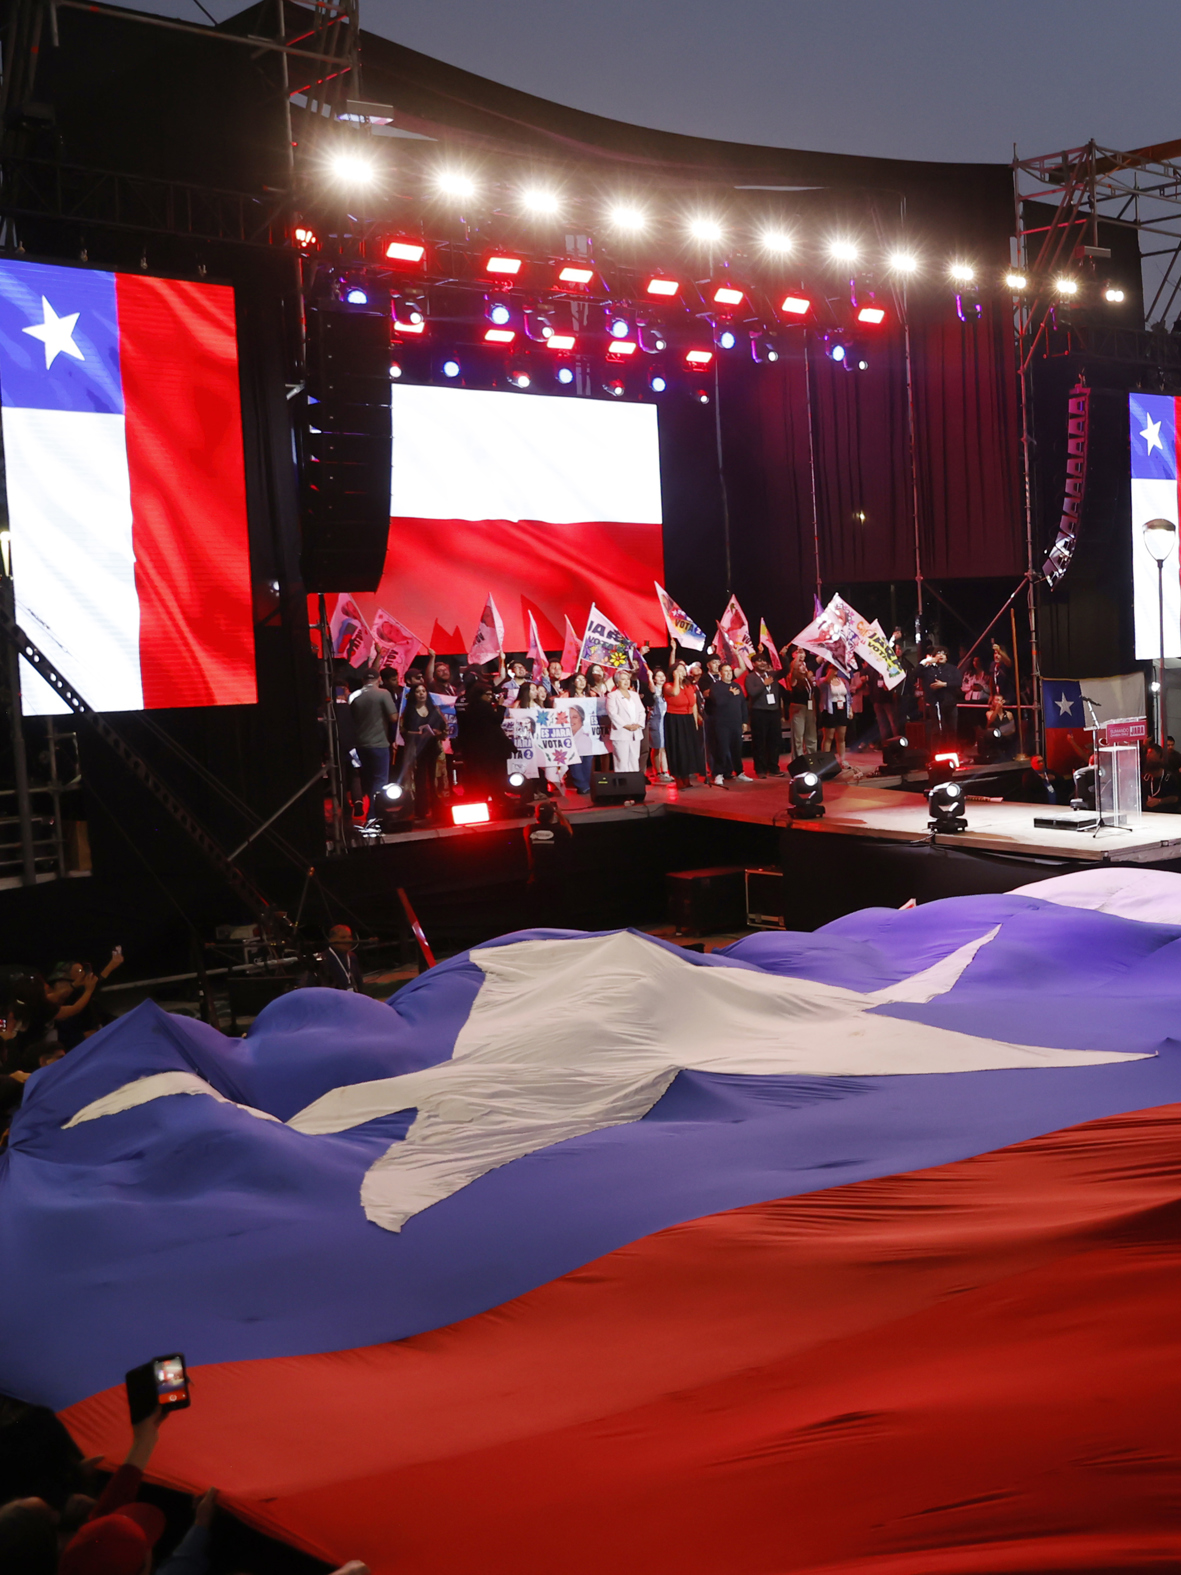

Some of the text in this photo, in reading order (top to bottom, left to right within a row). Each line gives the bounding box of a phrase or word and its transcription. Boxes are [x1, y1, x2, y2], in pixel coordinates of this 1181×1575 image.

[541, 728, 571, 738] ES JARA
[542, 739, 563, 748] VOTA
